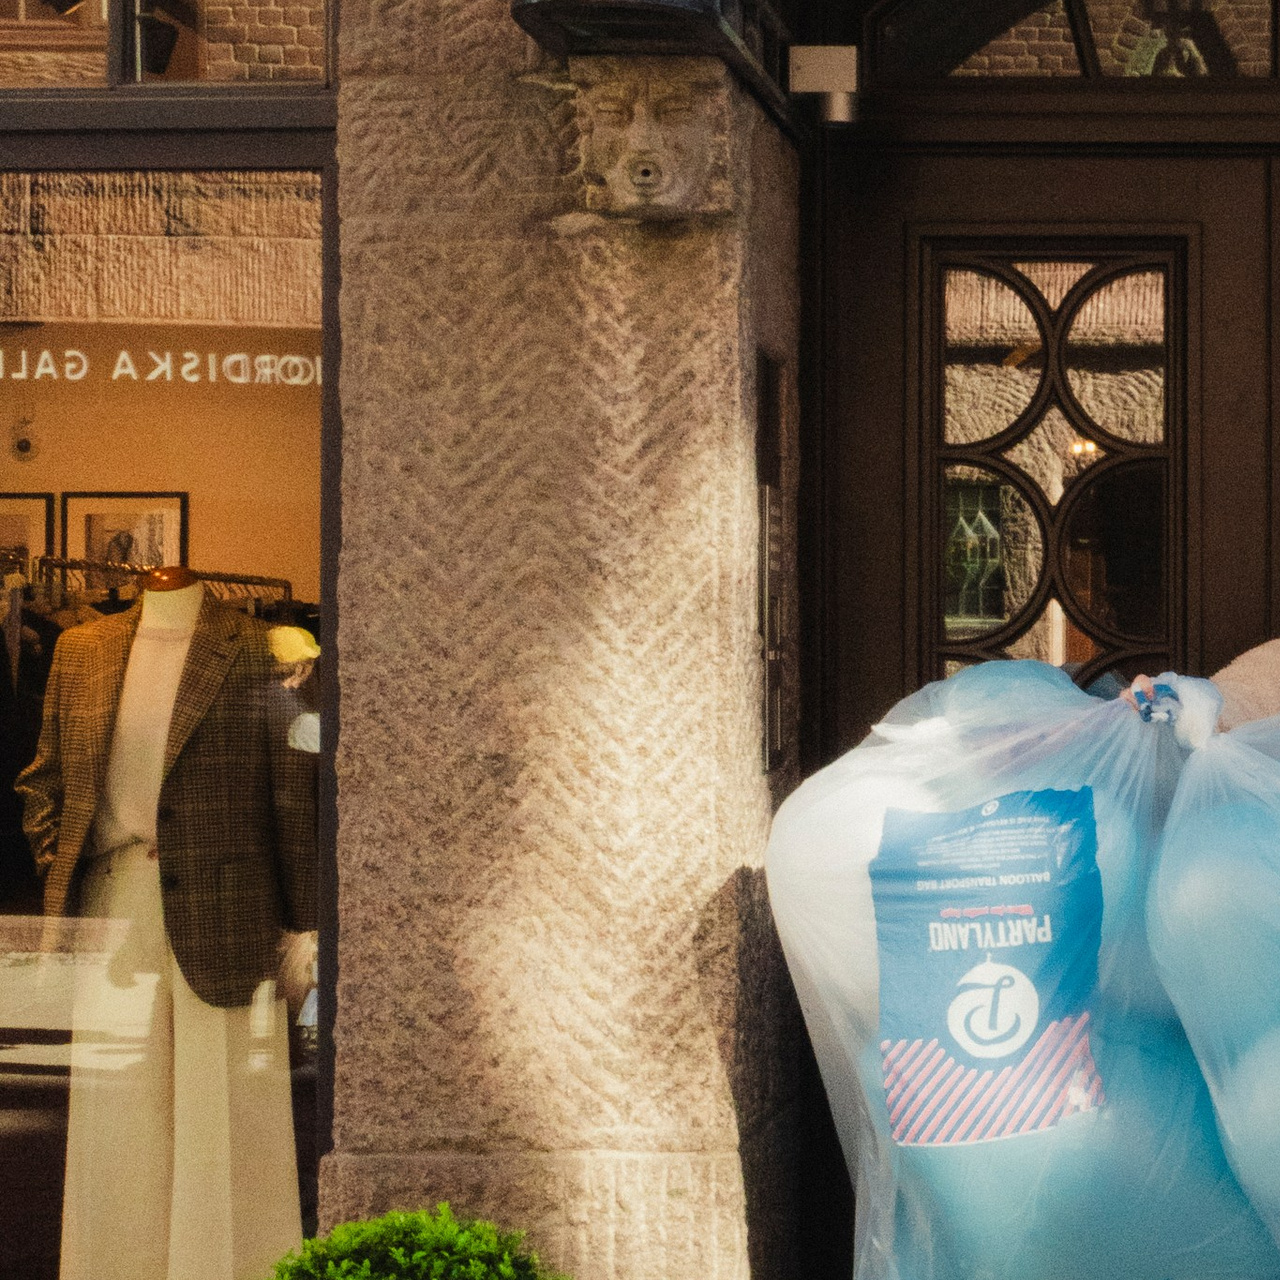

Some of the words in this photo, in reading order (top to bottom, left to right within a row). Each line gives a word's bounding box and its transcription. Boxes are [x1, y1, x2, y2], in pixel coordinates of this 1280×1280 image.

[916, 879, 938, 891] BAG
[940, 876, 997, 889] TRANSPORT
[999, 872, 1050, 886] BALLOON
[928, 915, 1052, 951] PARTYLAND
